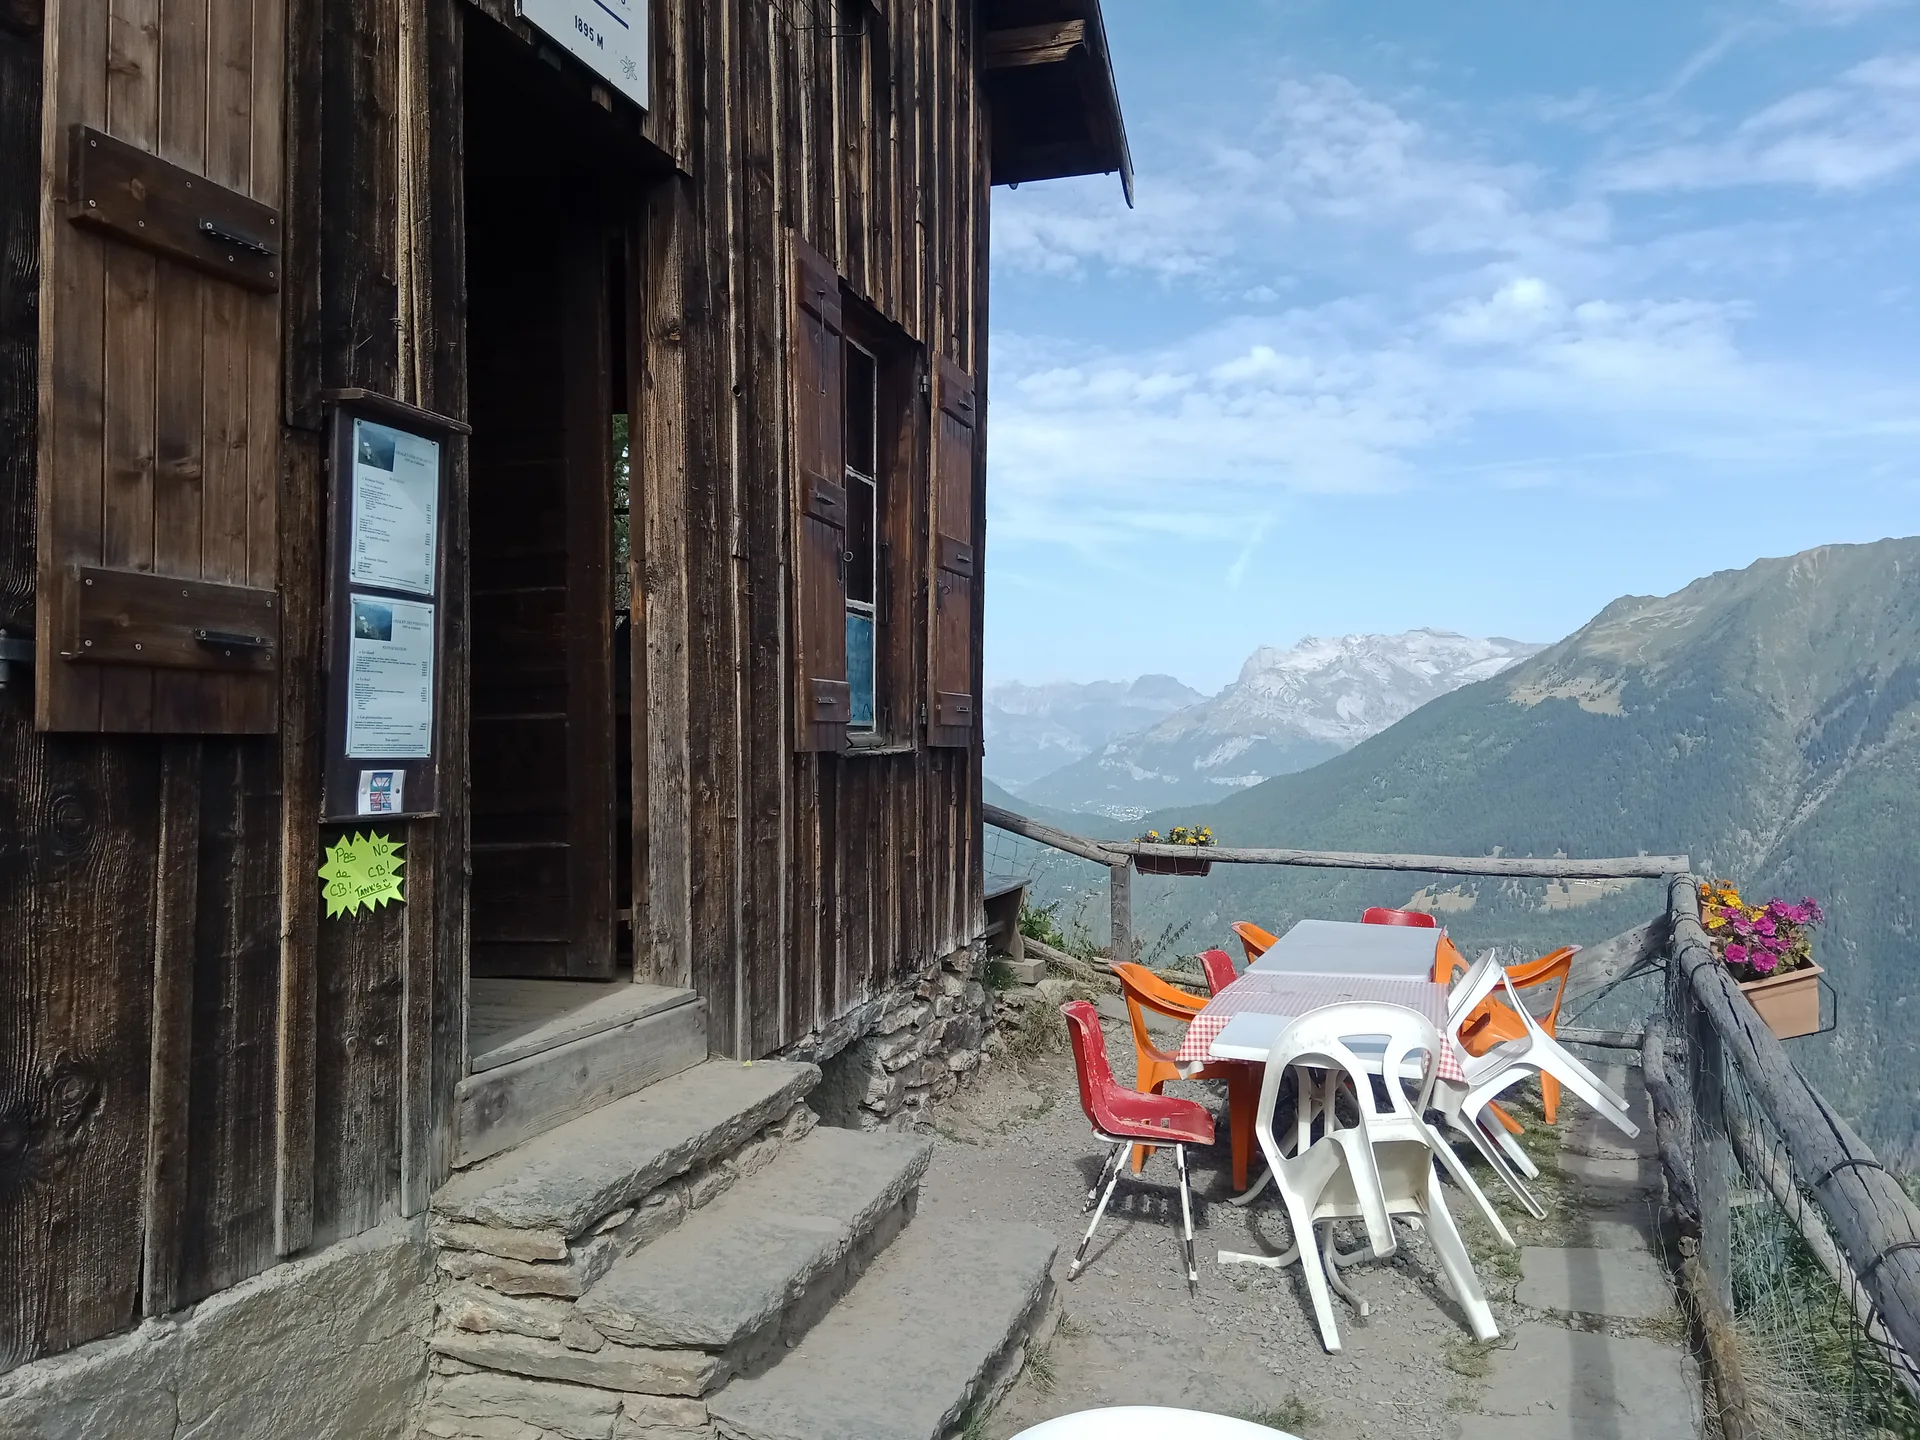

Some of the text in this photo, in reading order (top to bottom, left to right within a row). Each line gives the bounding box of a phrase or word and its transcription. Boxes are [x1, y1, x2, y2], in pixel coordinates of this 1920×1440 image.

[574, 15, 604, 50] 1895 M
[372, 843, 389, 857] NO
[336, 870, 351, 878] de
